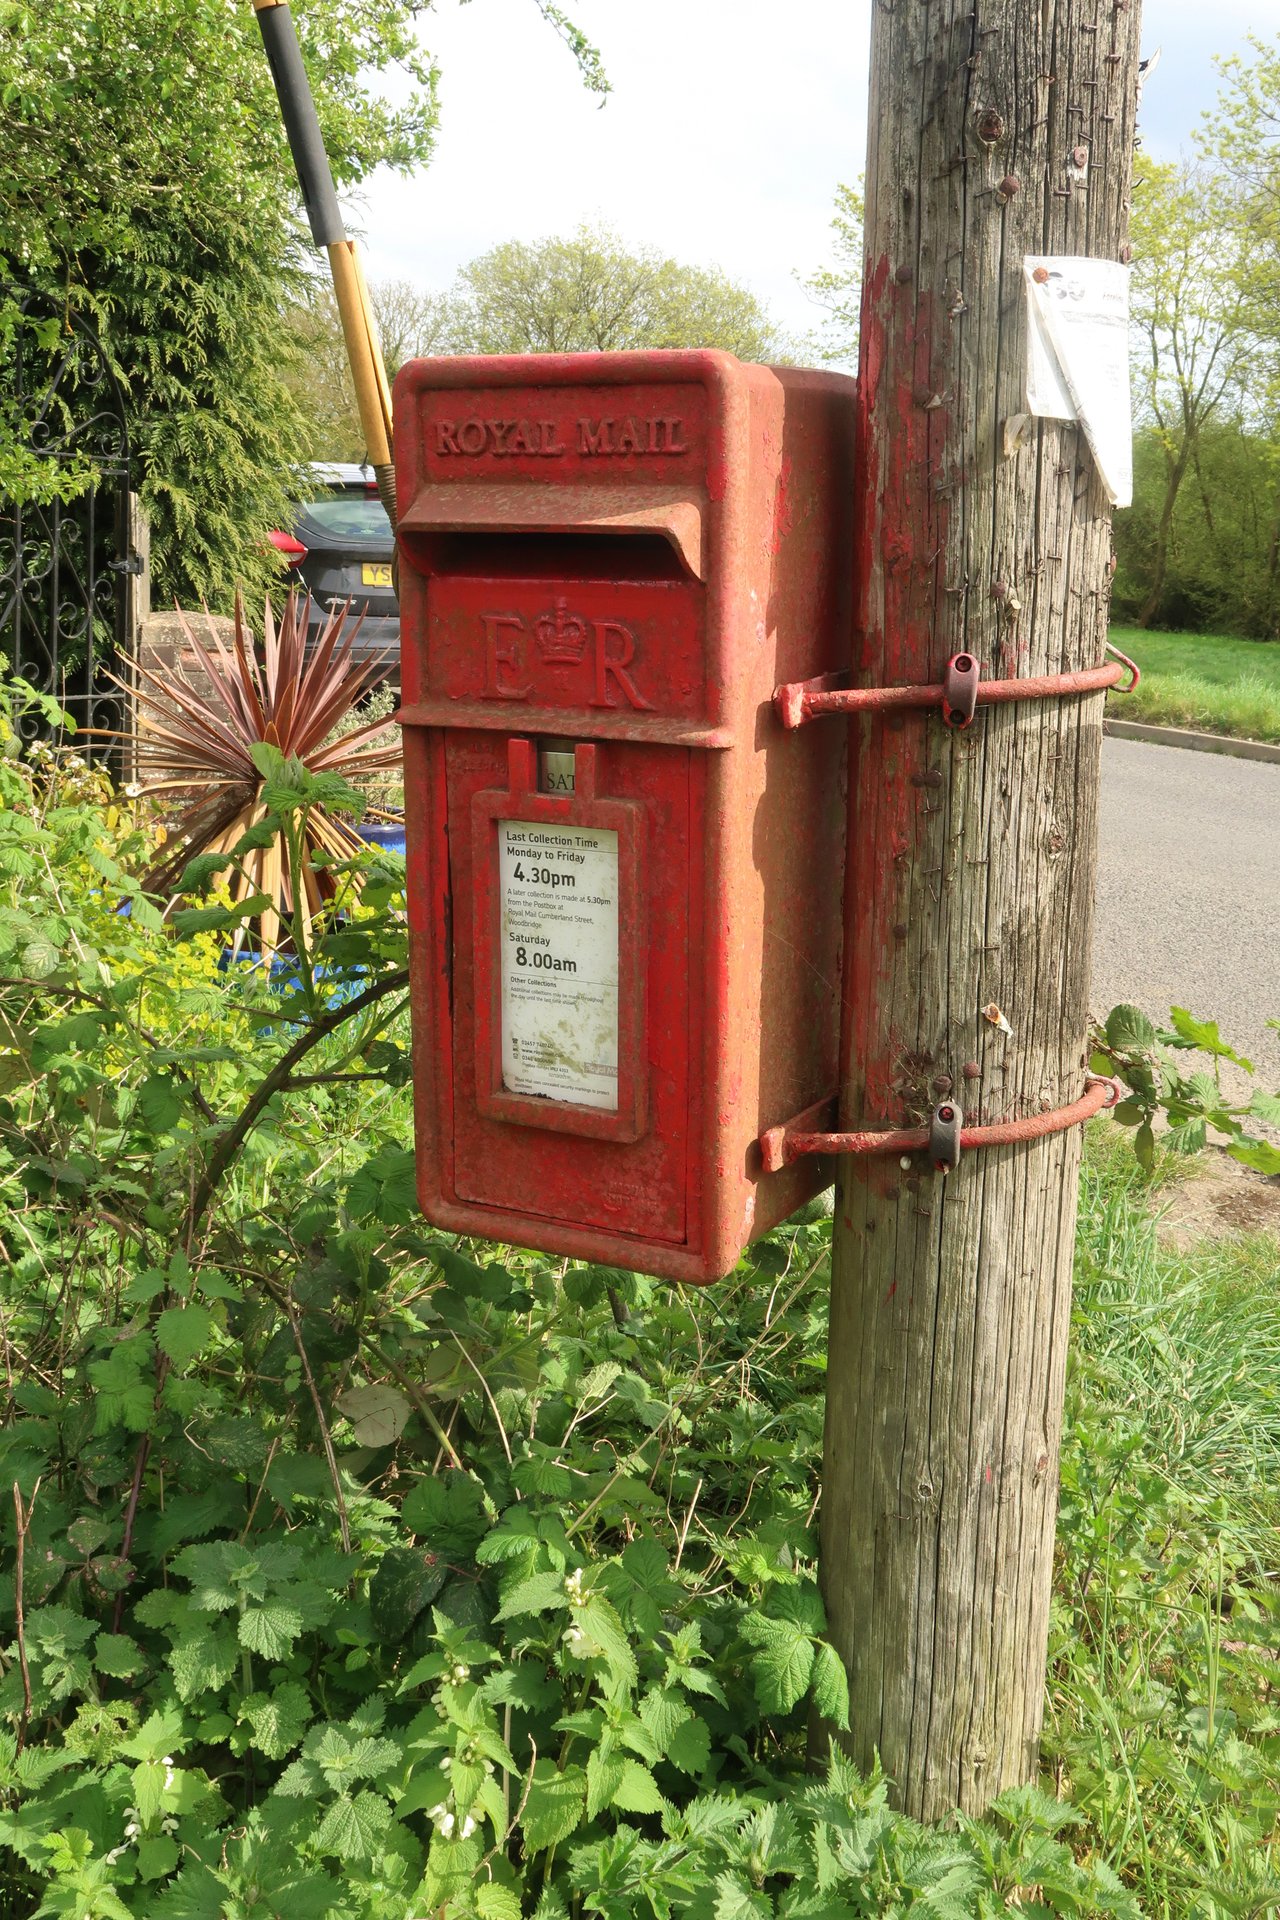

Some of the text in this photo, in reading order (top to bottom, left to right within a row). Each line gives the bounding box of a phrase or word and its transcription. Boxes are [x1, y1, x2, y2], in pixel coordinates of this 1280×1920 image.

[435, 416, 690, 458] ROYAL MAIL
[480, 614, 658, 712] E R
[506, 831, 599, 849] Last Collection Time
[507, 846, 586, 864] Monday to Friday
[513, 862, 576, 888] 4.30pm
[507, 899, 522, 907] from
[522, 900, 533, 908] the
[533, 901, 557, 910] Postbox
[513, 889, 526, 897] later
[527, 891, 553, 899] collection
[562, 894, 578, 902] made
[587, 896, 611, 906] 5.30pm
[508, 908, 524, 917] Royal
[525, 910, 537, 919] Mail
[538, 911, 574, 922] Cumberland
[508, 918, 542, 929] Woodbridge
[509, 932, 551, 947] Saturday
[516, 946, 577, 973] 8.00am
[510, 976, 557, 988] Other Collections
